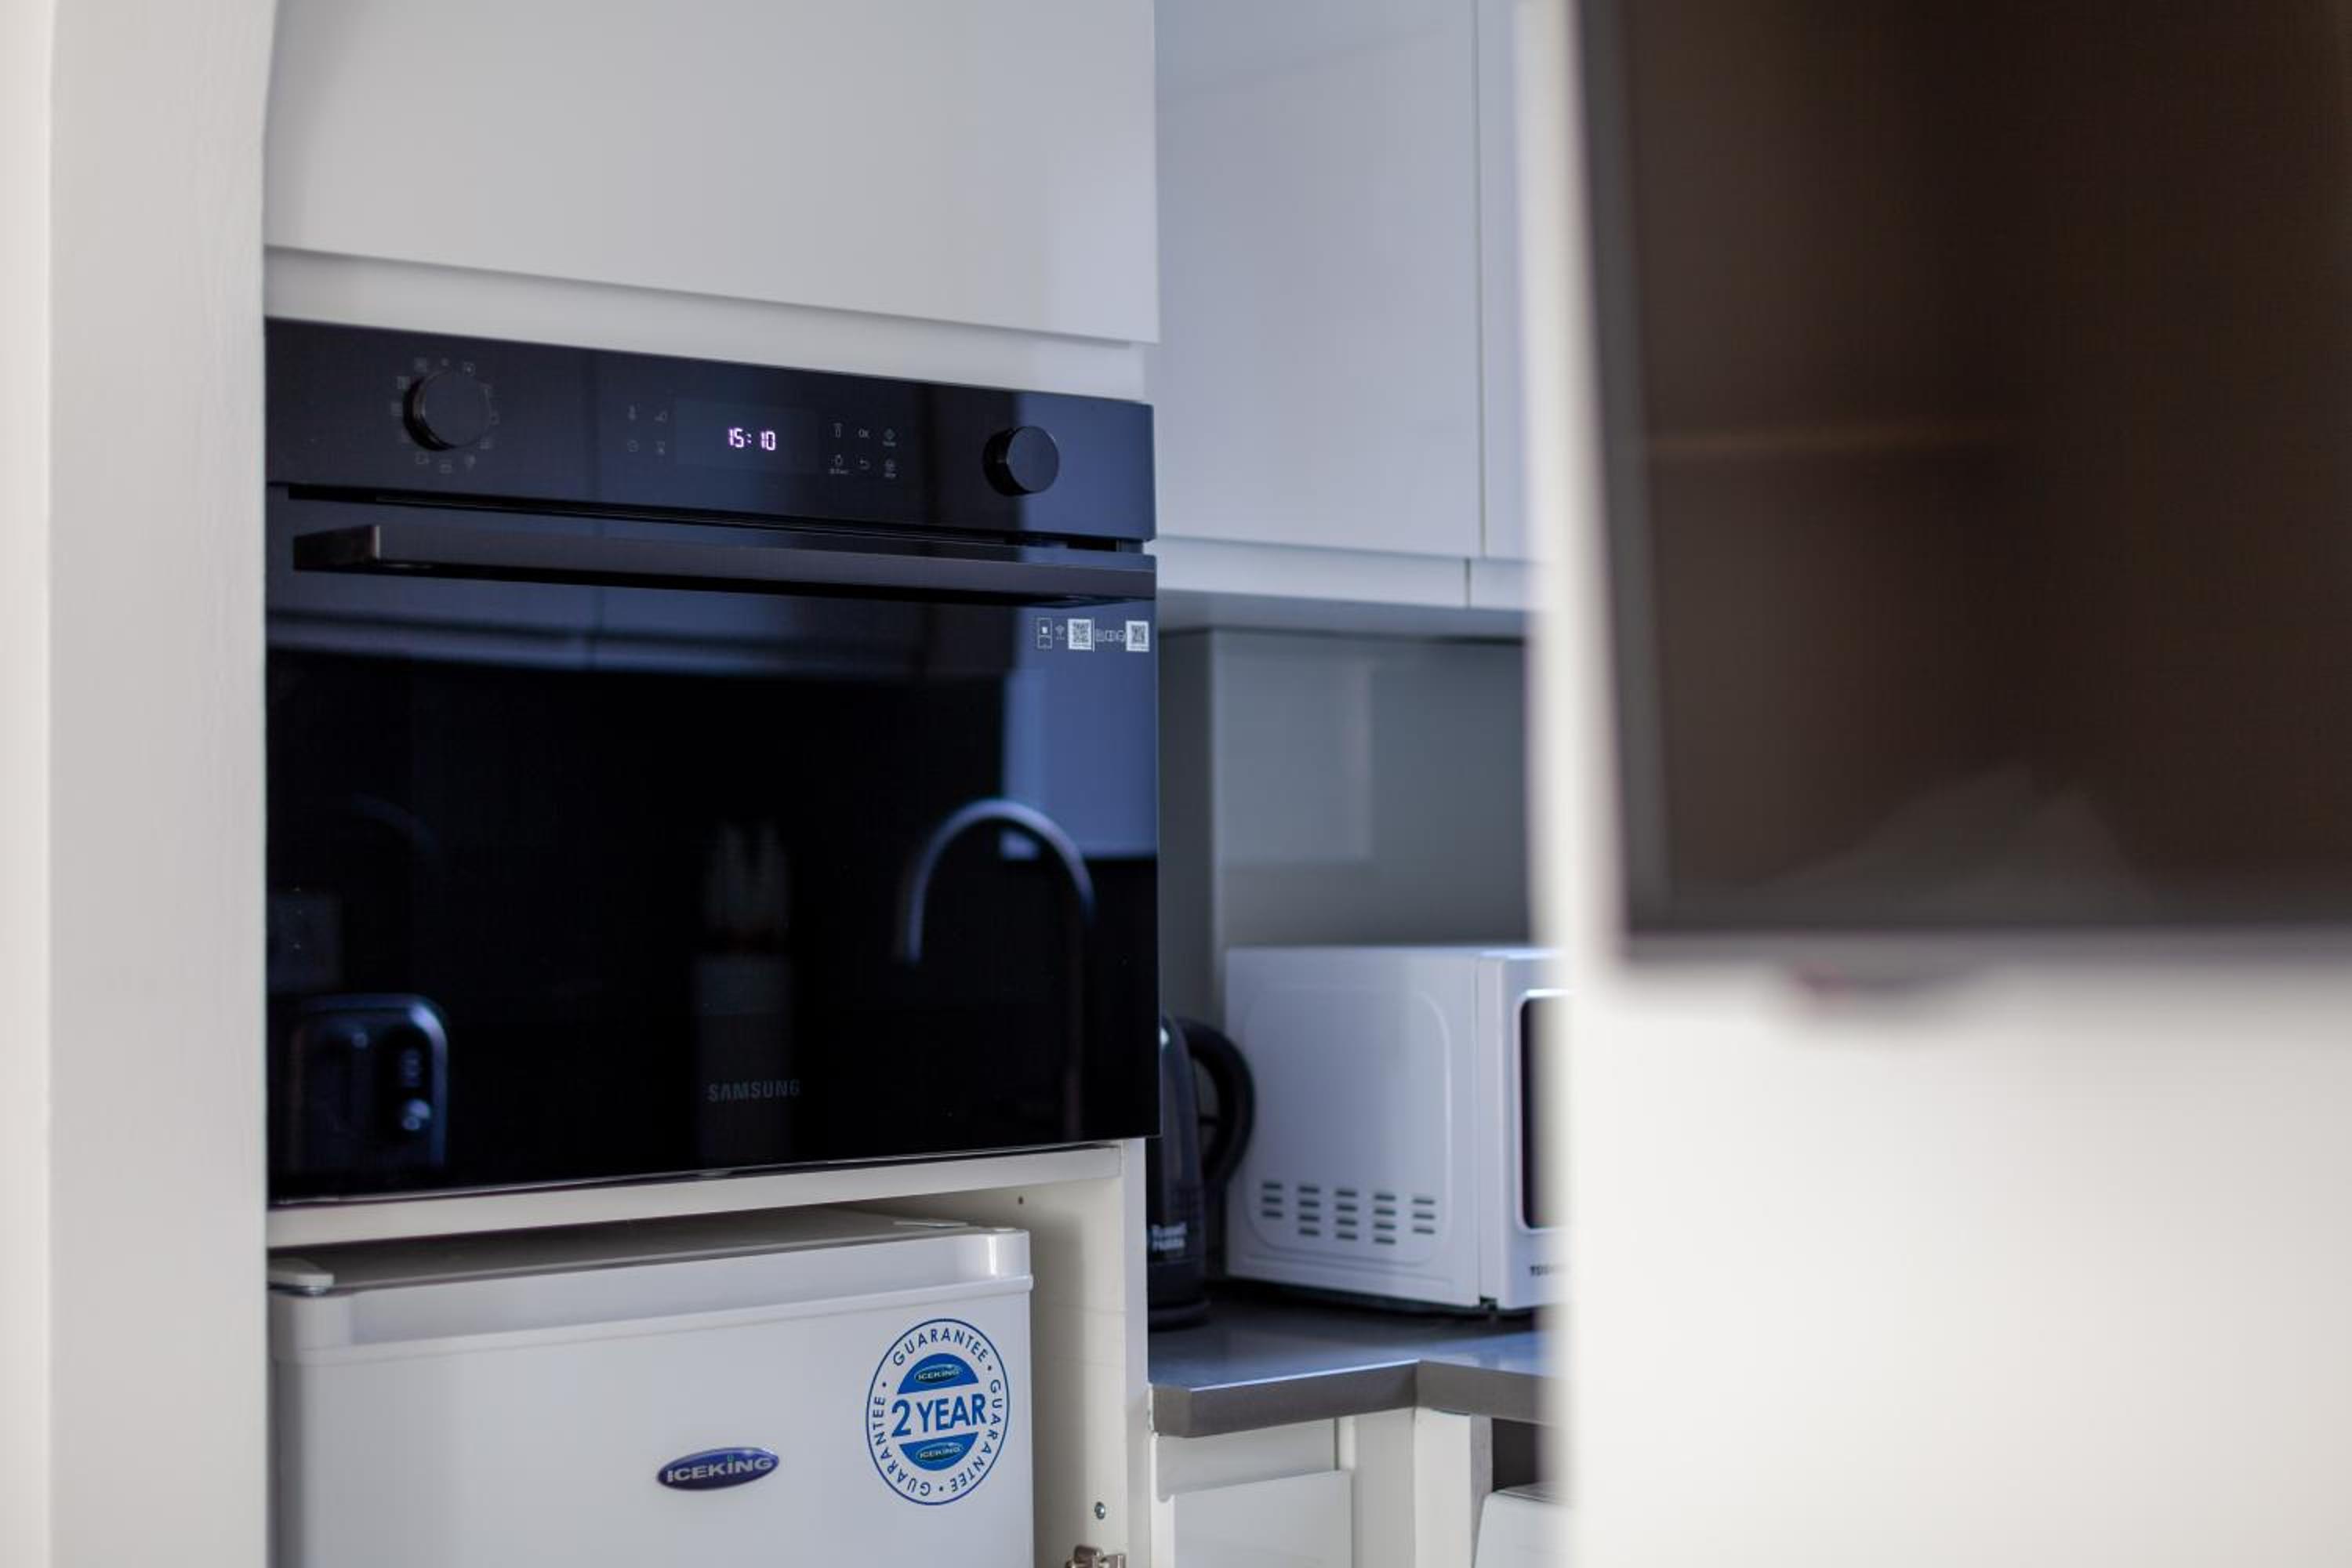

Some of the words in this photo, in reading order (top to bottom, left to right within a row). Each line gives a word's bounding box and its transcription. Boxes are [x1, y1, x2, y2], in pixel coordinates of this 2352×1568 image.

[728, 427, 775, 450] 15:10
[707, 1080, 800, 1102] SAMSUNG
[893, 1327, 989, 1367] GUARANTEE
[891, 1399, 912, 1437] 2
[916, 1393, 987, 1433] YEAR
[873, 1396, 931, 1497] GUARANTEE
[950, 1379, 1003, 1493] GUARANTEE
[666, 1455, 774, 1483] ICEKING
